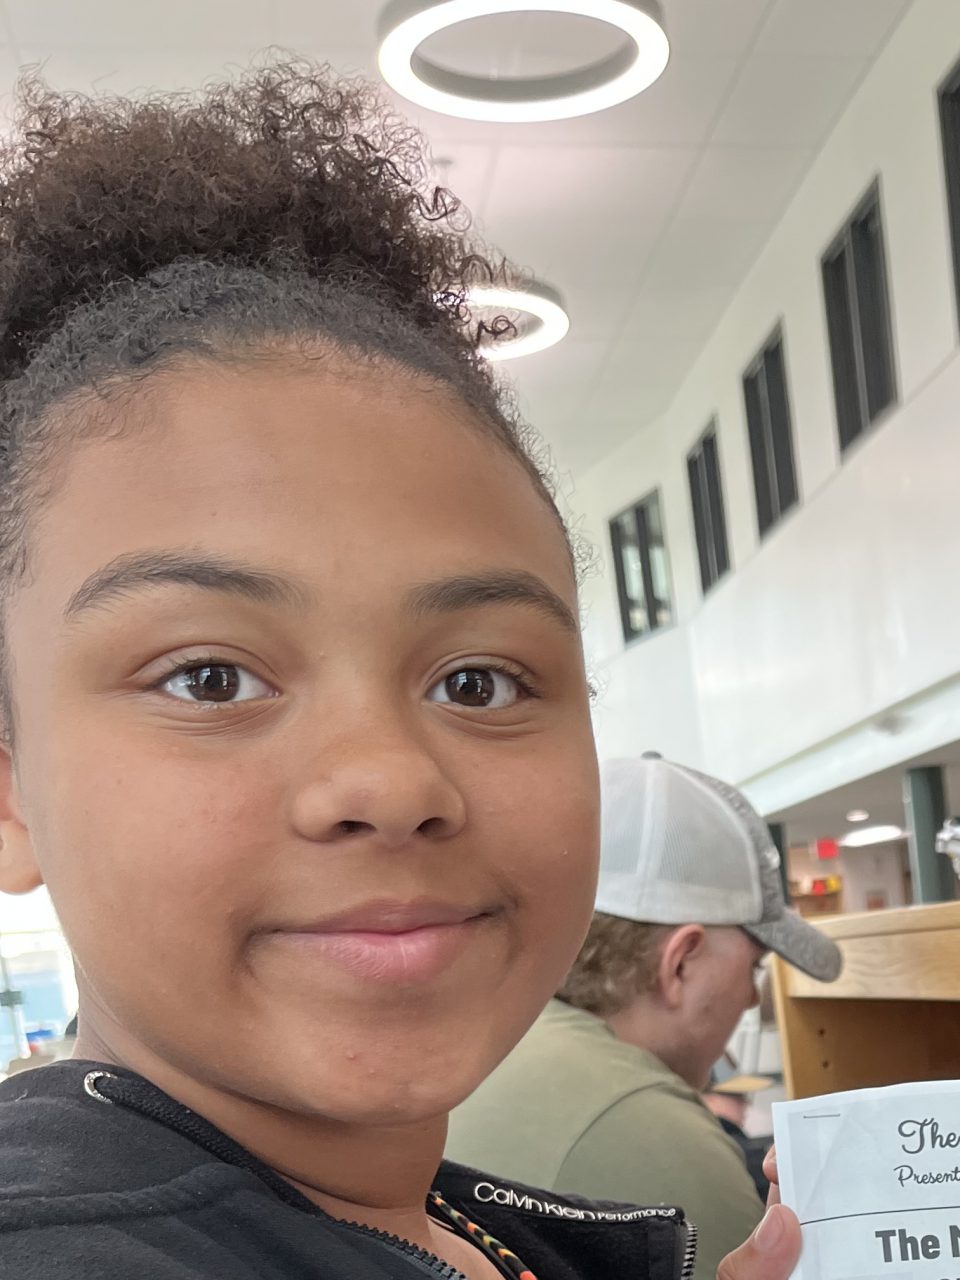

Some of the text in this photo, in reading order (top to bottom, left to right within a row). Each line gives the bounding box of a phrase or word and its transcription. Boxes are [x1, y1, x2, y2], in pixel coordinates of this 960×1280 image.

[474, 1182, 543, 1213] Calvin
[545, 1204, 596, 1221] Klein
[875, 1229, 940, 1263] The
